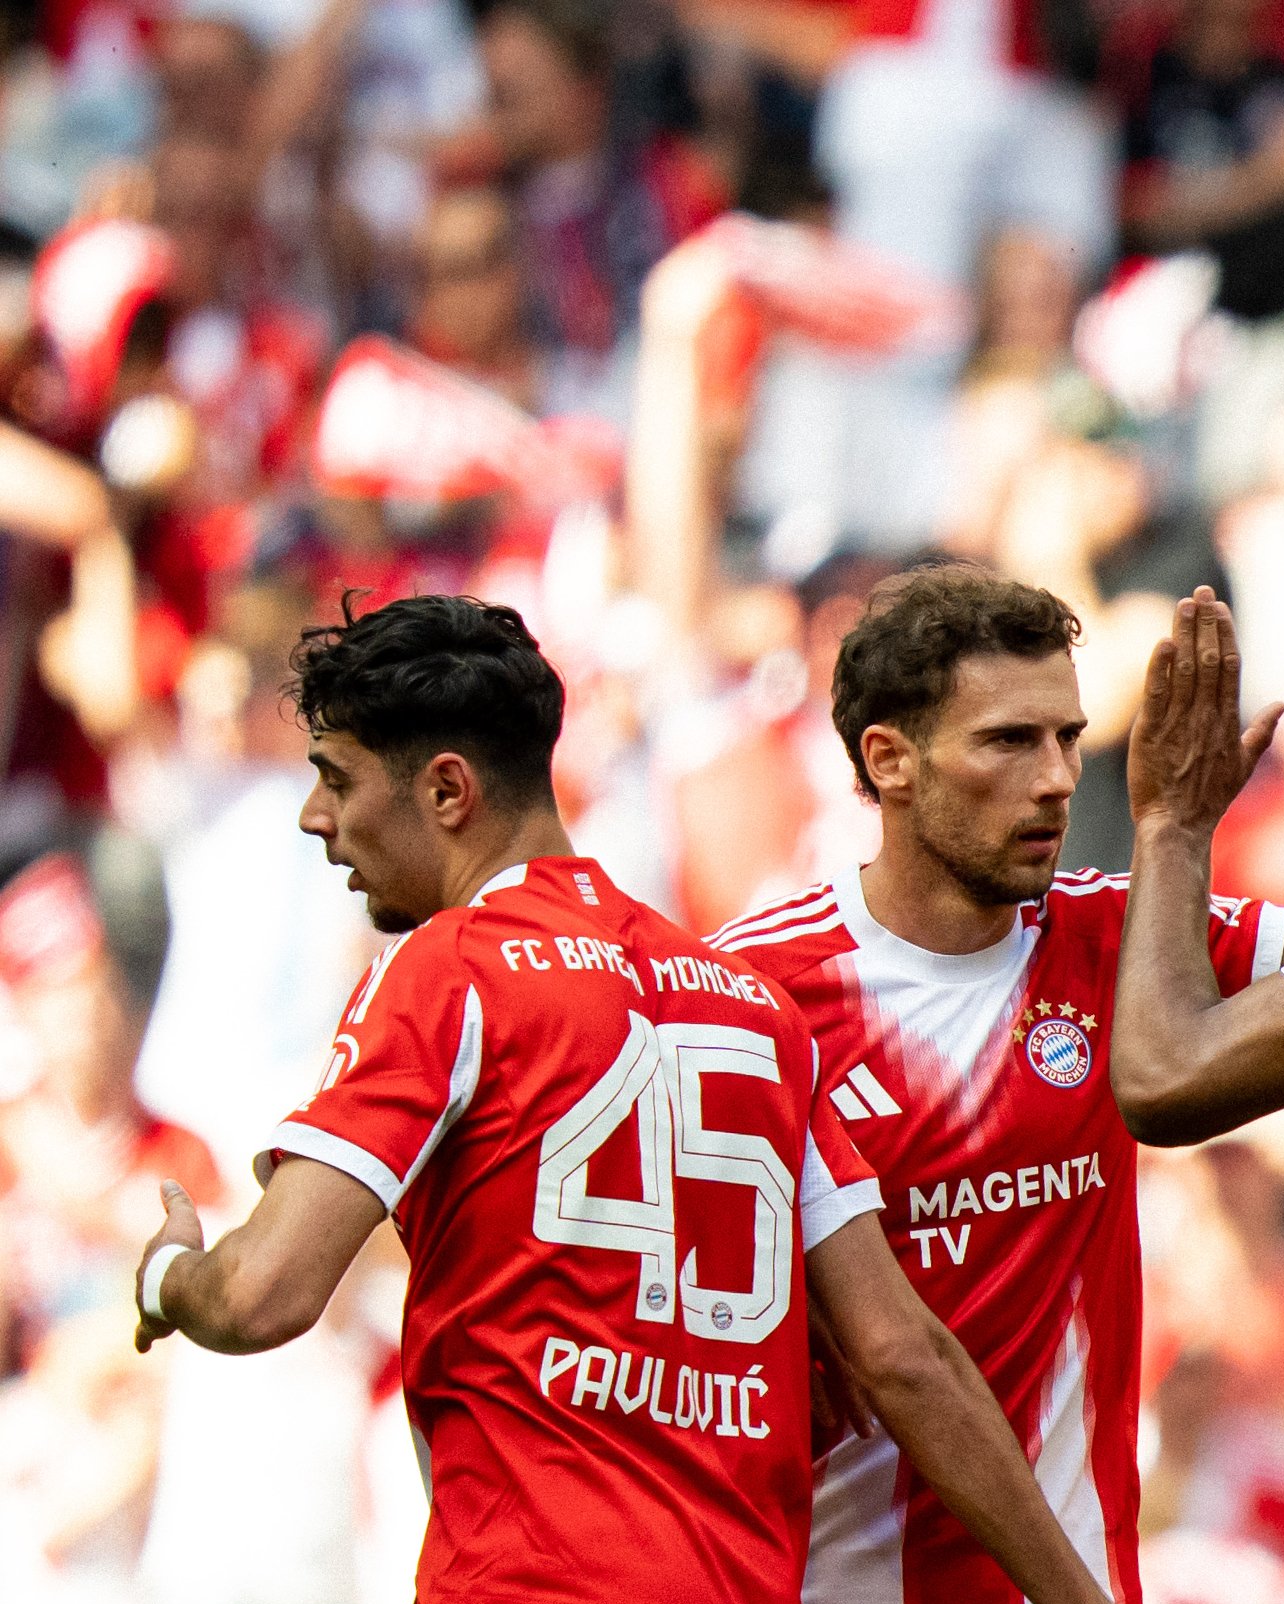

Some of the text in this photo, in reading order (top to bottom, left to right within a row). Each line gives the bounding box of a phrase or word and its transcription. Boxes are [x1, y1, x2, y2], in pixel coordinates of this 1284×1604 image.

[500, 939, 551, 971] FC
[1039, 1023, 1083, 1047] BAYERN
[532, 1009, 795, 1343] 45
[909, 1152, 1106, 1223] MAGENTA
[909, 1224, 972, 1269] TV
[540, 1336, 771, 1439] PAVLOVIĆ
